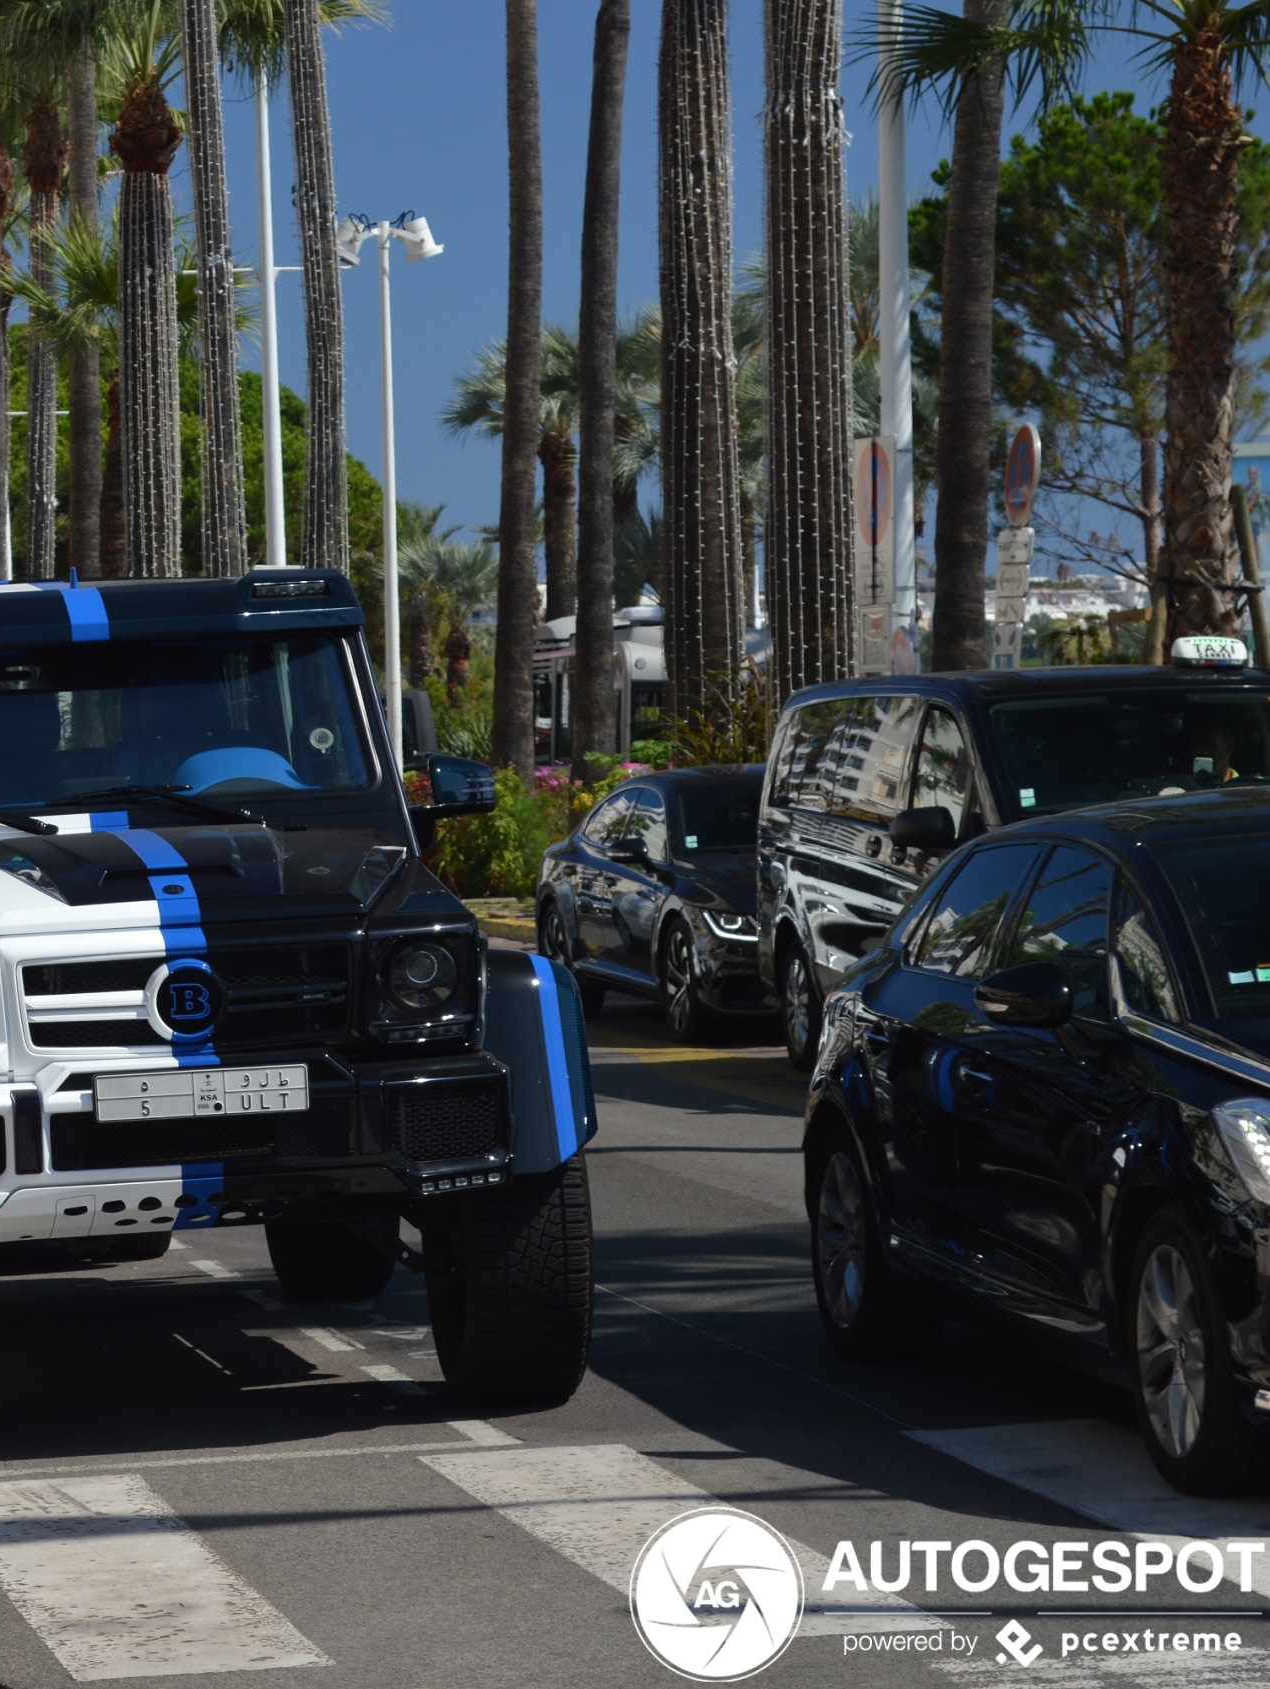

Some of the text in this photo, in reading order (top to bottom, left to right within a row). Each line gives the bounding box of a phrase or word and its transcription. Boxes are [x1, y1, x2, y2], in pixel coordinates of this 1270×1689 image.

[1193, 643, 1236, 654] TAXI
[169, 982, 212, 1020] B
[200, 1094, 218, 1102] KSA
[141, 1098, 151, 1117] 5
